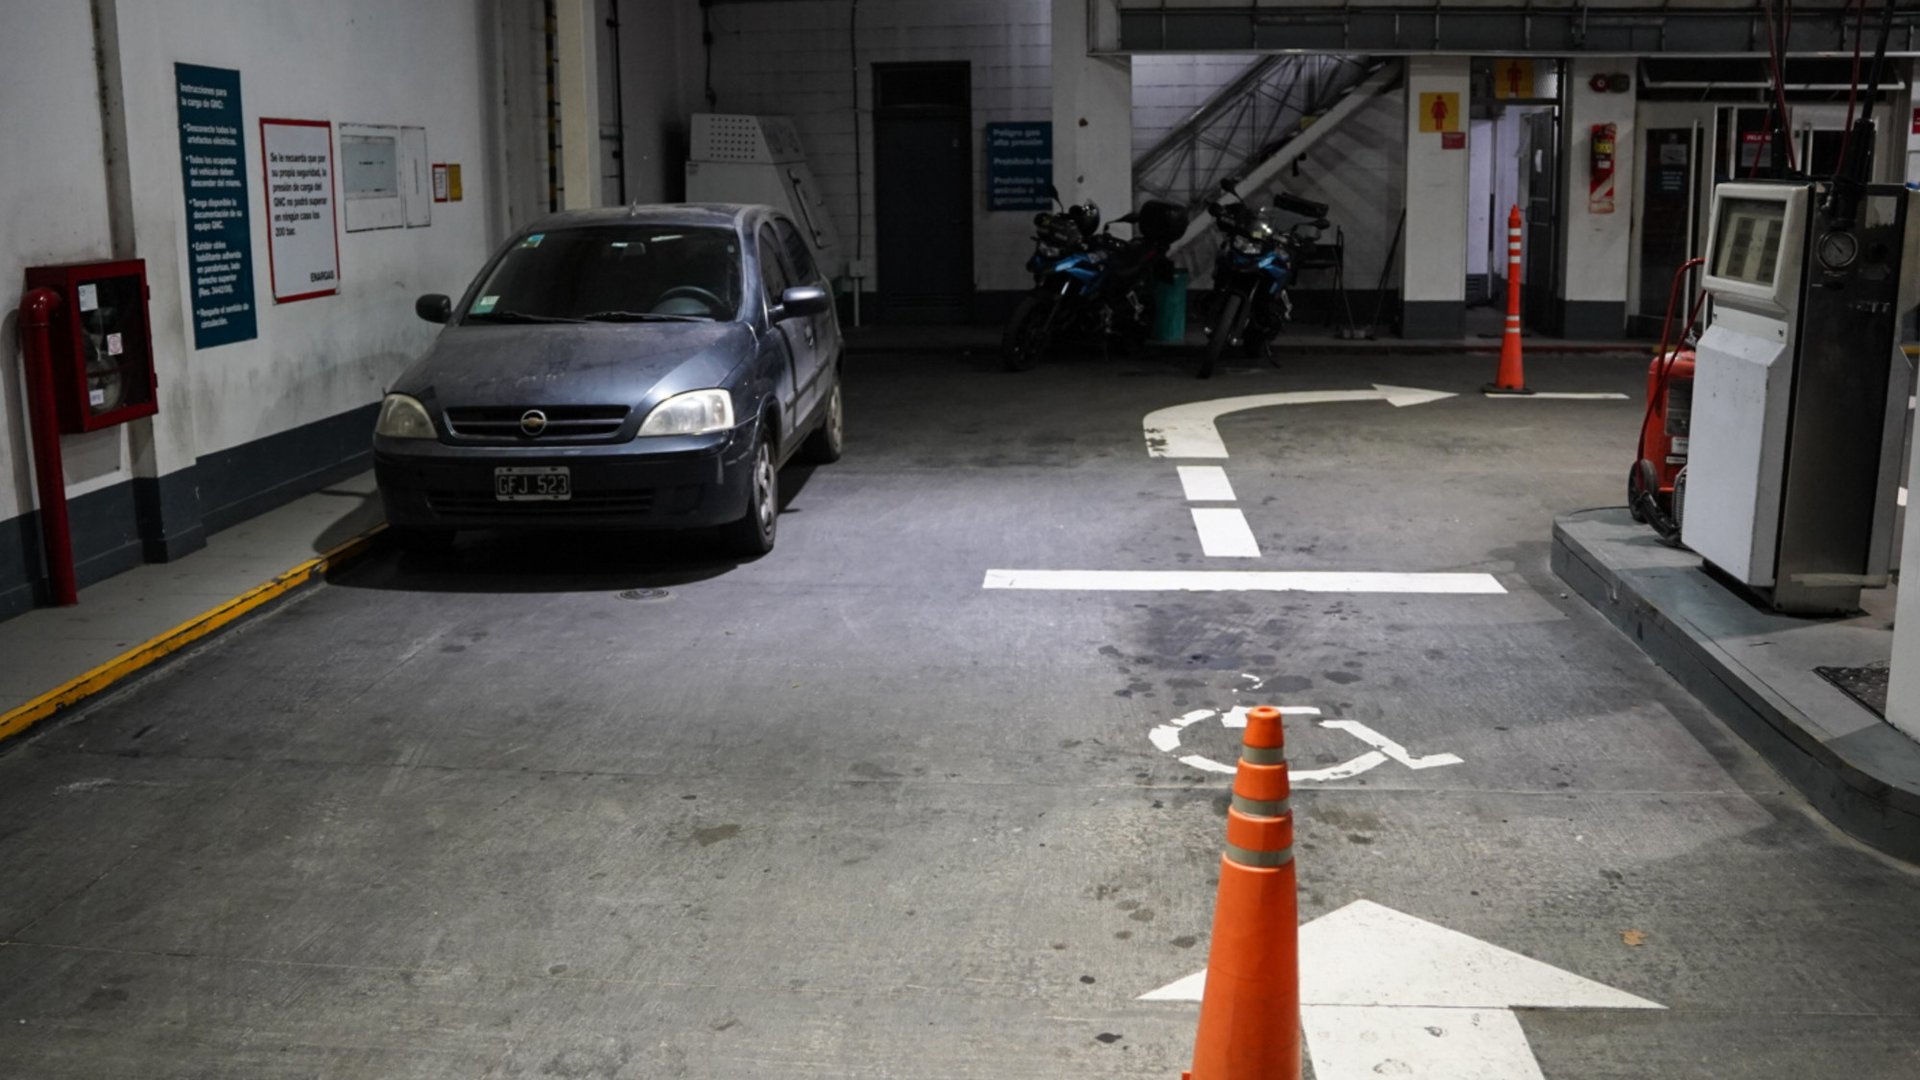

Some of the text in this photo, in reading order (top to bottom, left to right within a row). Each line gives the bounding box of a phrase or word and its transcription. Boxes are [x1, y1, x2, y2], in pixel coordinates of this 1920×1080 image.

[180, 83, 215, 95] Instrucciones
[187, 99, 202, 109] carga
[993, 128, 1023, 138] Peligro
[190, 155, 204, 164] Todos
[270, 152, 278, 162] Se
[279, 152, 284, 162] le
[308, 155, 316, 164] que
[318, 155, 326, 164] por
[993, 157, 1052, 166] Prohibido fum
[310, 270, 334, 282] ENARGAS
[499, 476, 567, 494] GFJ 523
